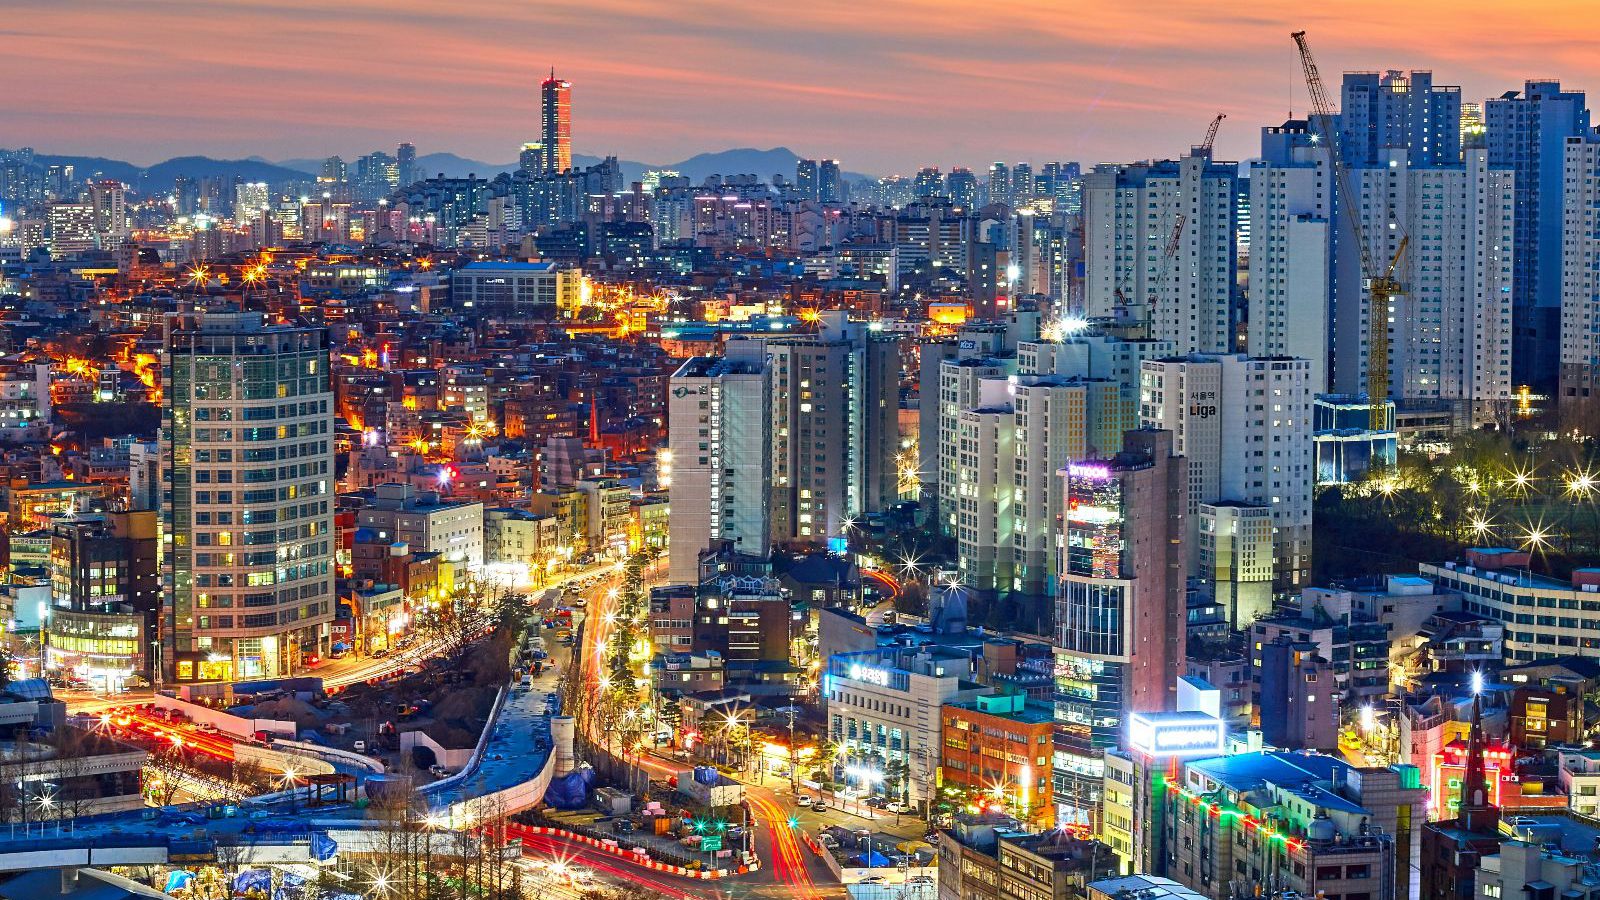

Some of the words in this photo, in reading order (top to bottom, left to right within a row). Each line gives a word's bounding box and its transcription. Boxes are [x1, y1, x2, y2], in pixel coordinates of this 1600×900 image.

[960, 341, 973, 349] KCC
[1191, 392, 1215, 400] 서울역
[1190, 403, 1216, 419] Liga
